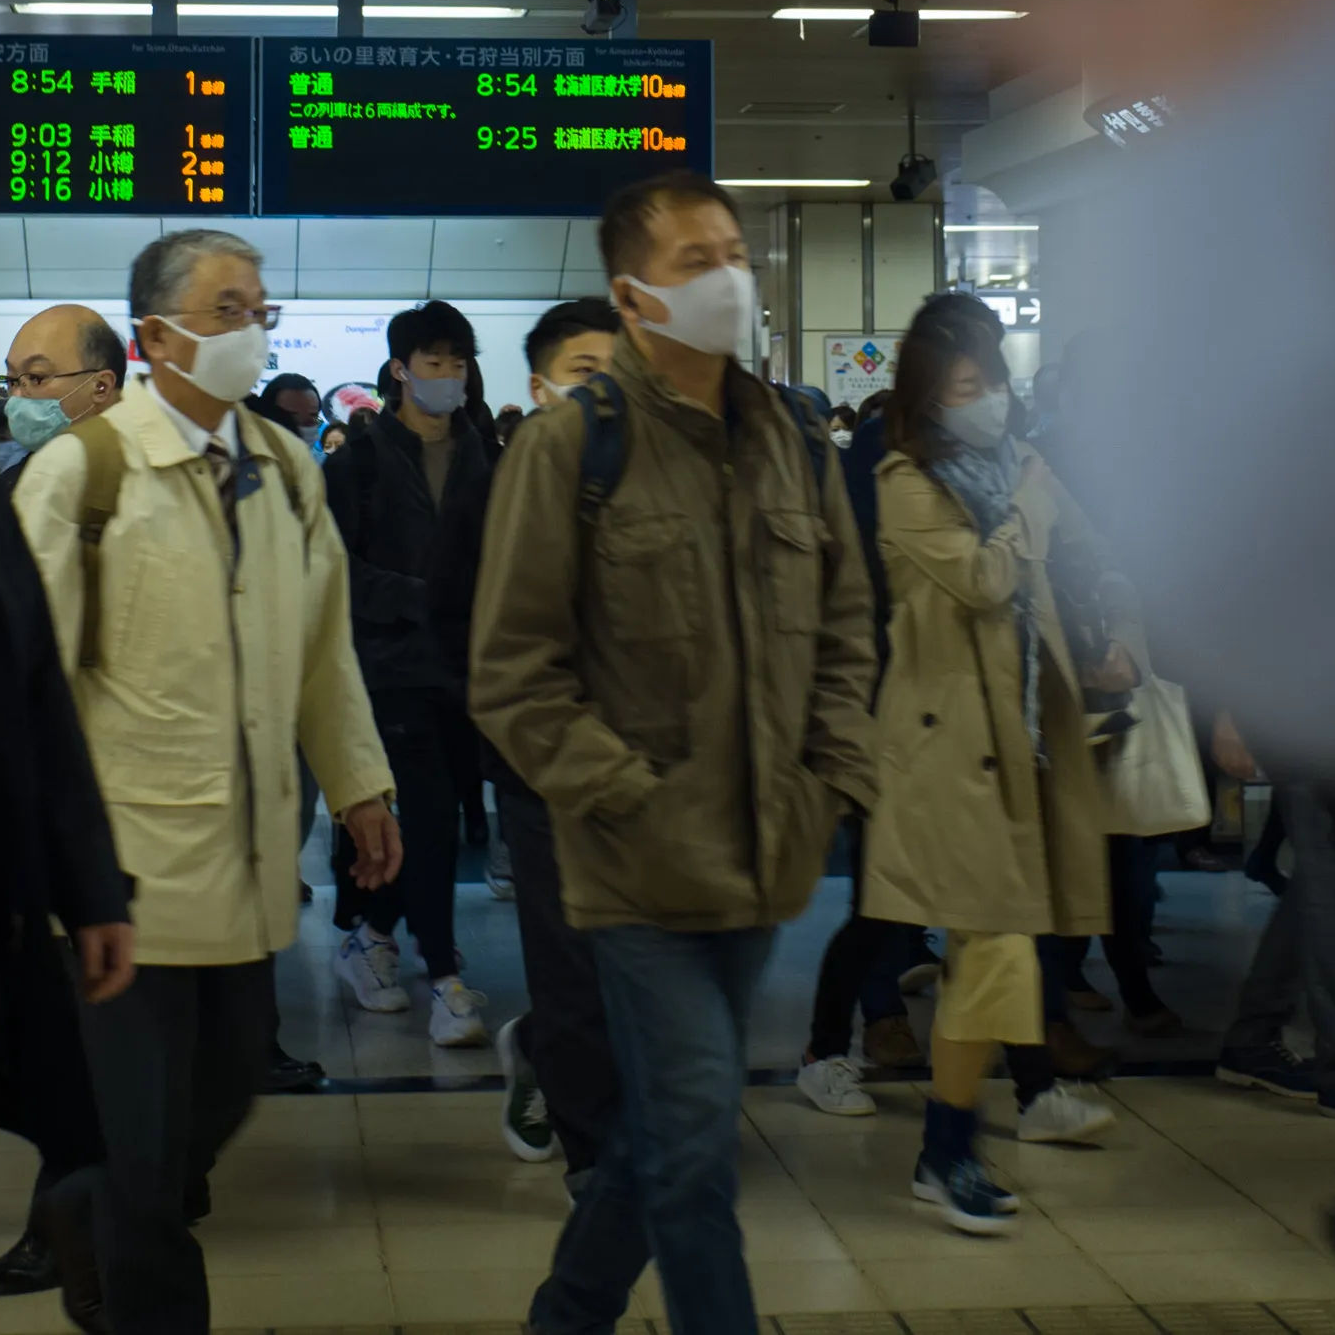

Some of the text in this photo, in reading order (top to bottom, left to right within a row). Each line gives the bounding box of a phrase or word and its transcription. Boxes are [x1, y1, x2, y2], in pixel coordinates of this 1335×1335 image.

[290, 46, 585, 68] あいの里教育大・石狩当別方面
[11, 70, 73, 95] 8:54
[91, 71, 136, 95] 手稲
[289, 72, 333, 96] 普通
[477, 74, 537, 97] 8:54
[554, 74, 642, 97] 北海道医療大学
[289, 103, 457, 120] この列車は6両編成です。
[11, 123, 72, 148] 9:03
[90, 124, 135, 148] 手稲
[289, 125, 333, 149] 普通
[477, 127, 537, 150] 9:25
[554, 127, 642, 151] 北海道医療大学
[10, 150, 71, 175] 9:12
[89, 151, 134, 175] 小樽
[10, 177, 72, 202] 9:16
[89, 177, 134, 202] 小樽
